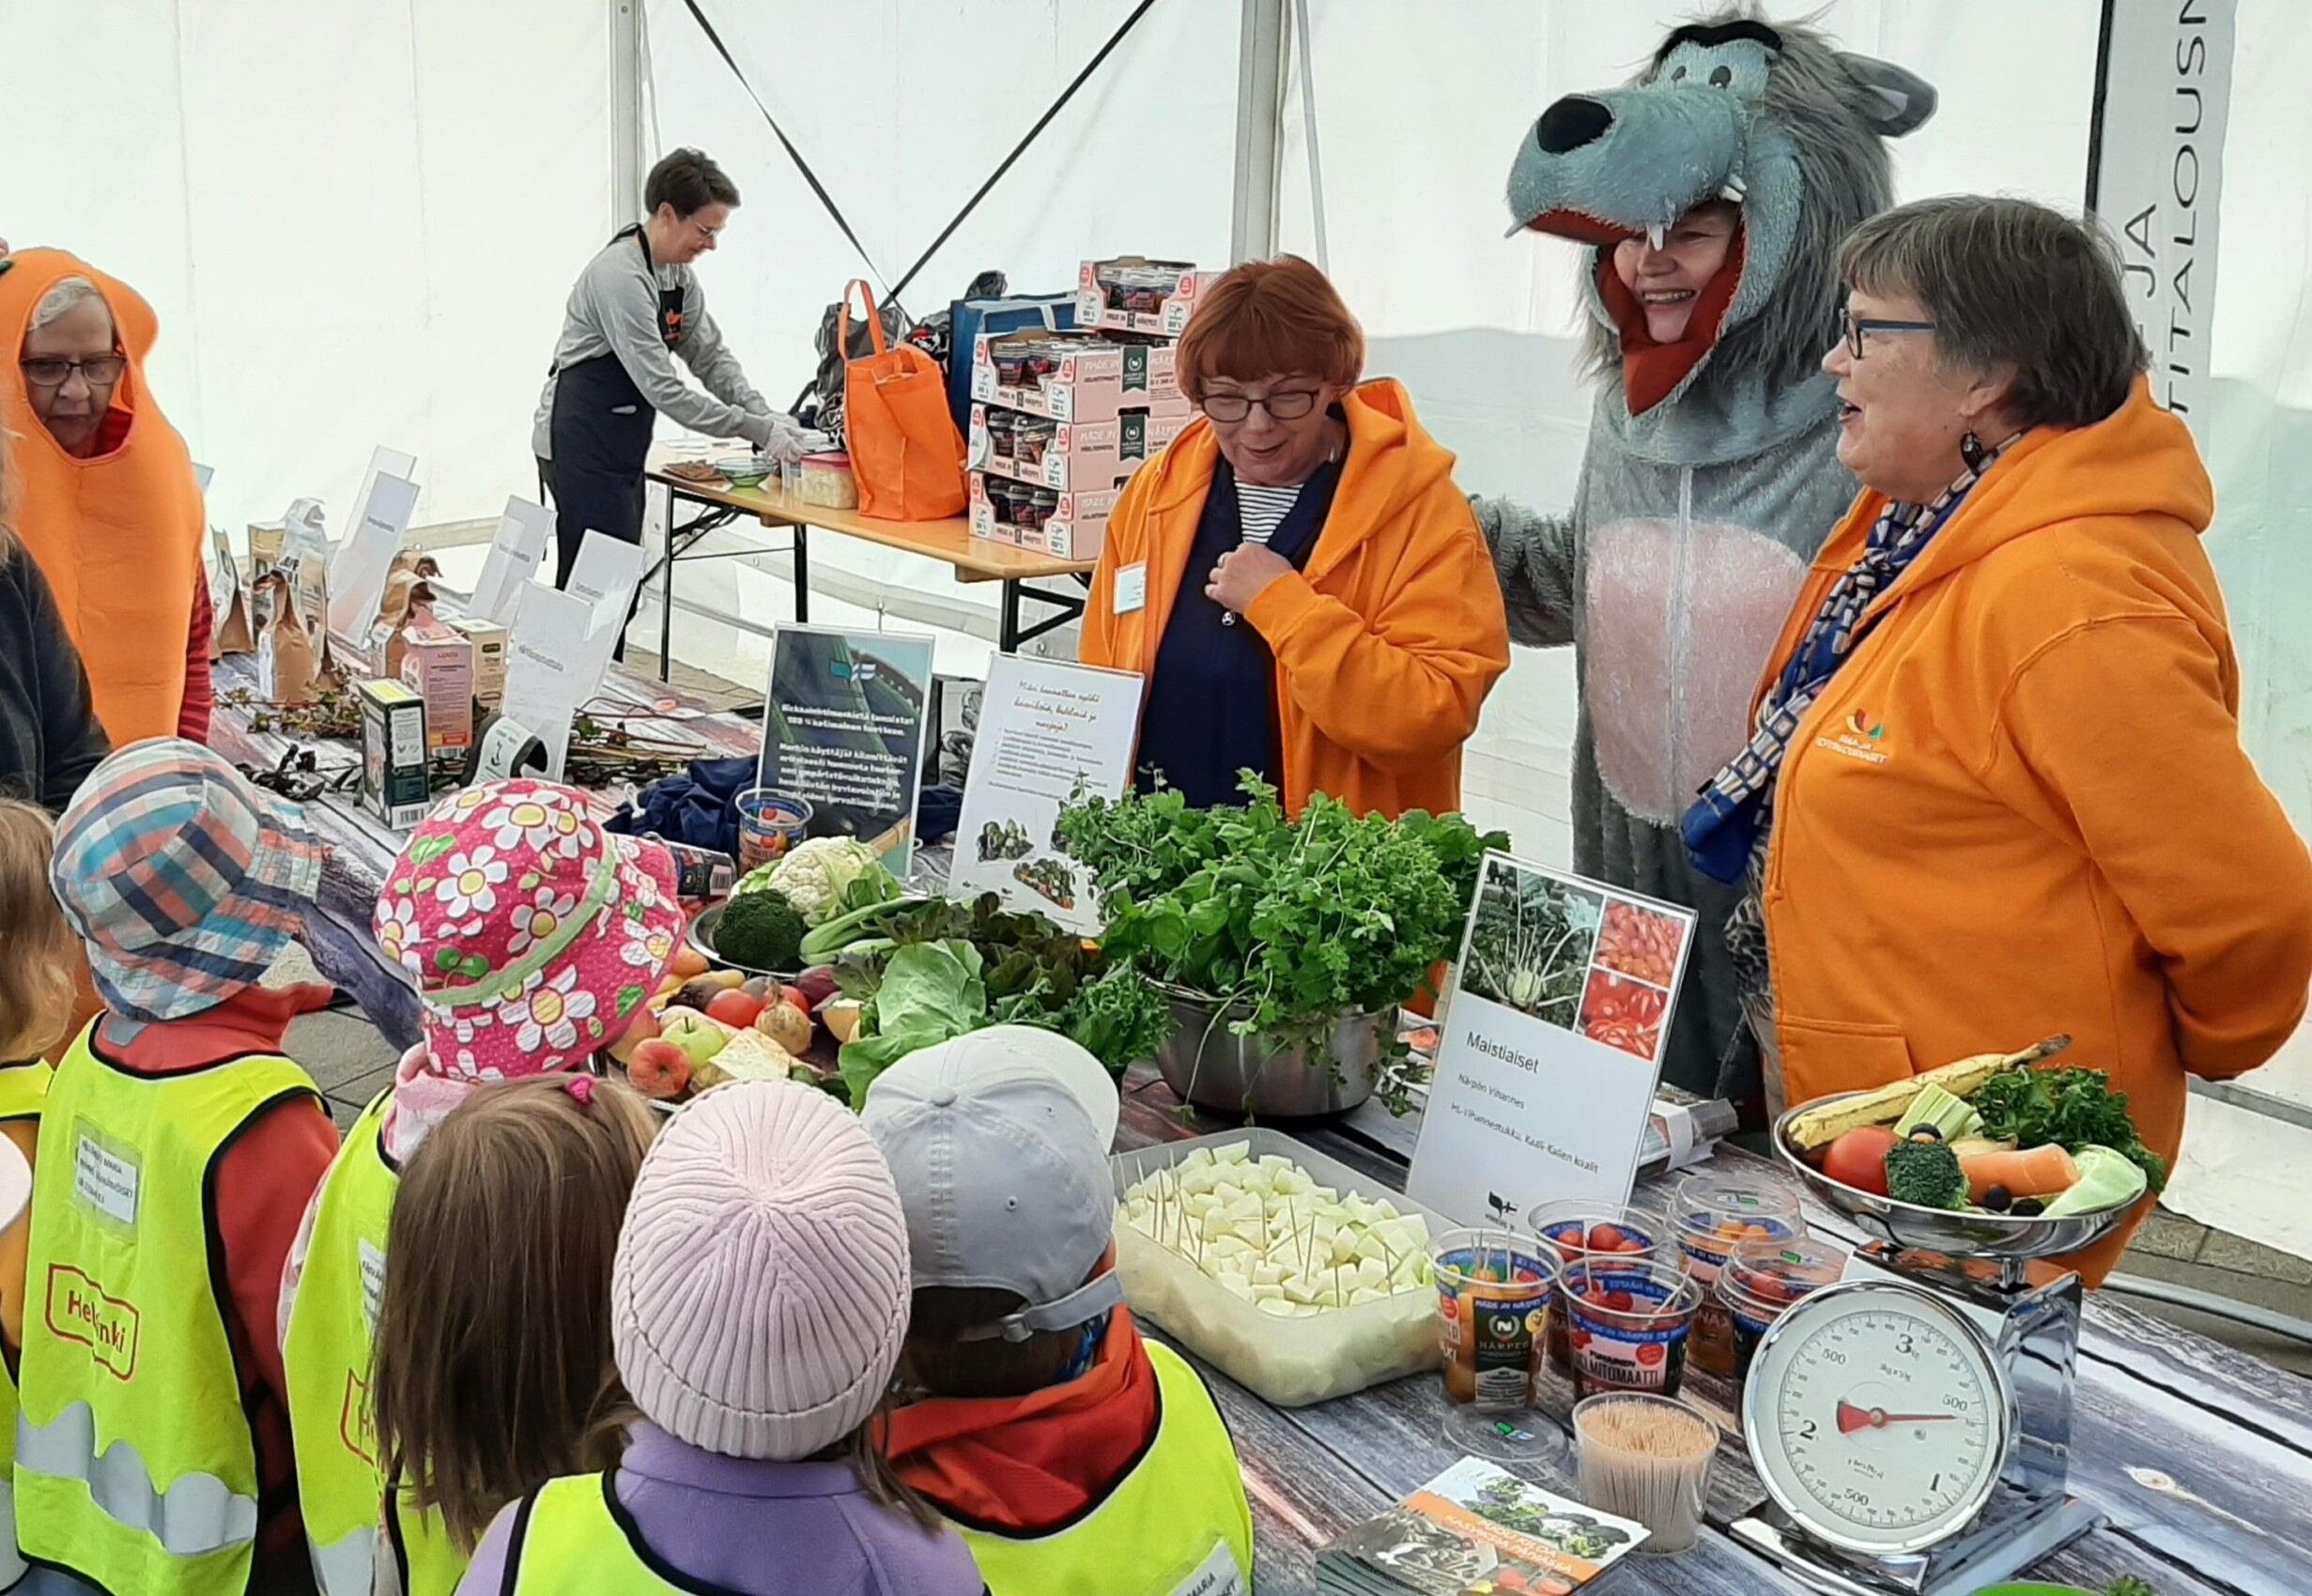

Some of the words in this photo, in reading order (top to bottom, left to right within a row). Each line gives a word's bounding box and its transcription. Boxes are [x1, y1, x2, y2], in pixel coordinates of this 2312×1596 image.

[2123, 203, 2157, 299] JA
[1467, 1031, 1540, 1074] Maistiaiset
[68, 1290, 126, 1354] Helnki
[1895, 1333, 1914, 1354] 3
[1822, 1348, 1846, 1365] 500
[1942, 1393, 1968, 1412] 500
[1799, 1420, 1817, 1441] 2
[1930, 1473, 1940, 1492] 1
[1843, 1488, 1869, 1506] 500
